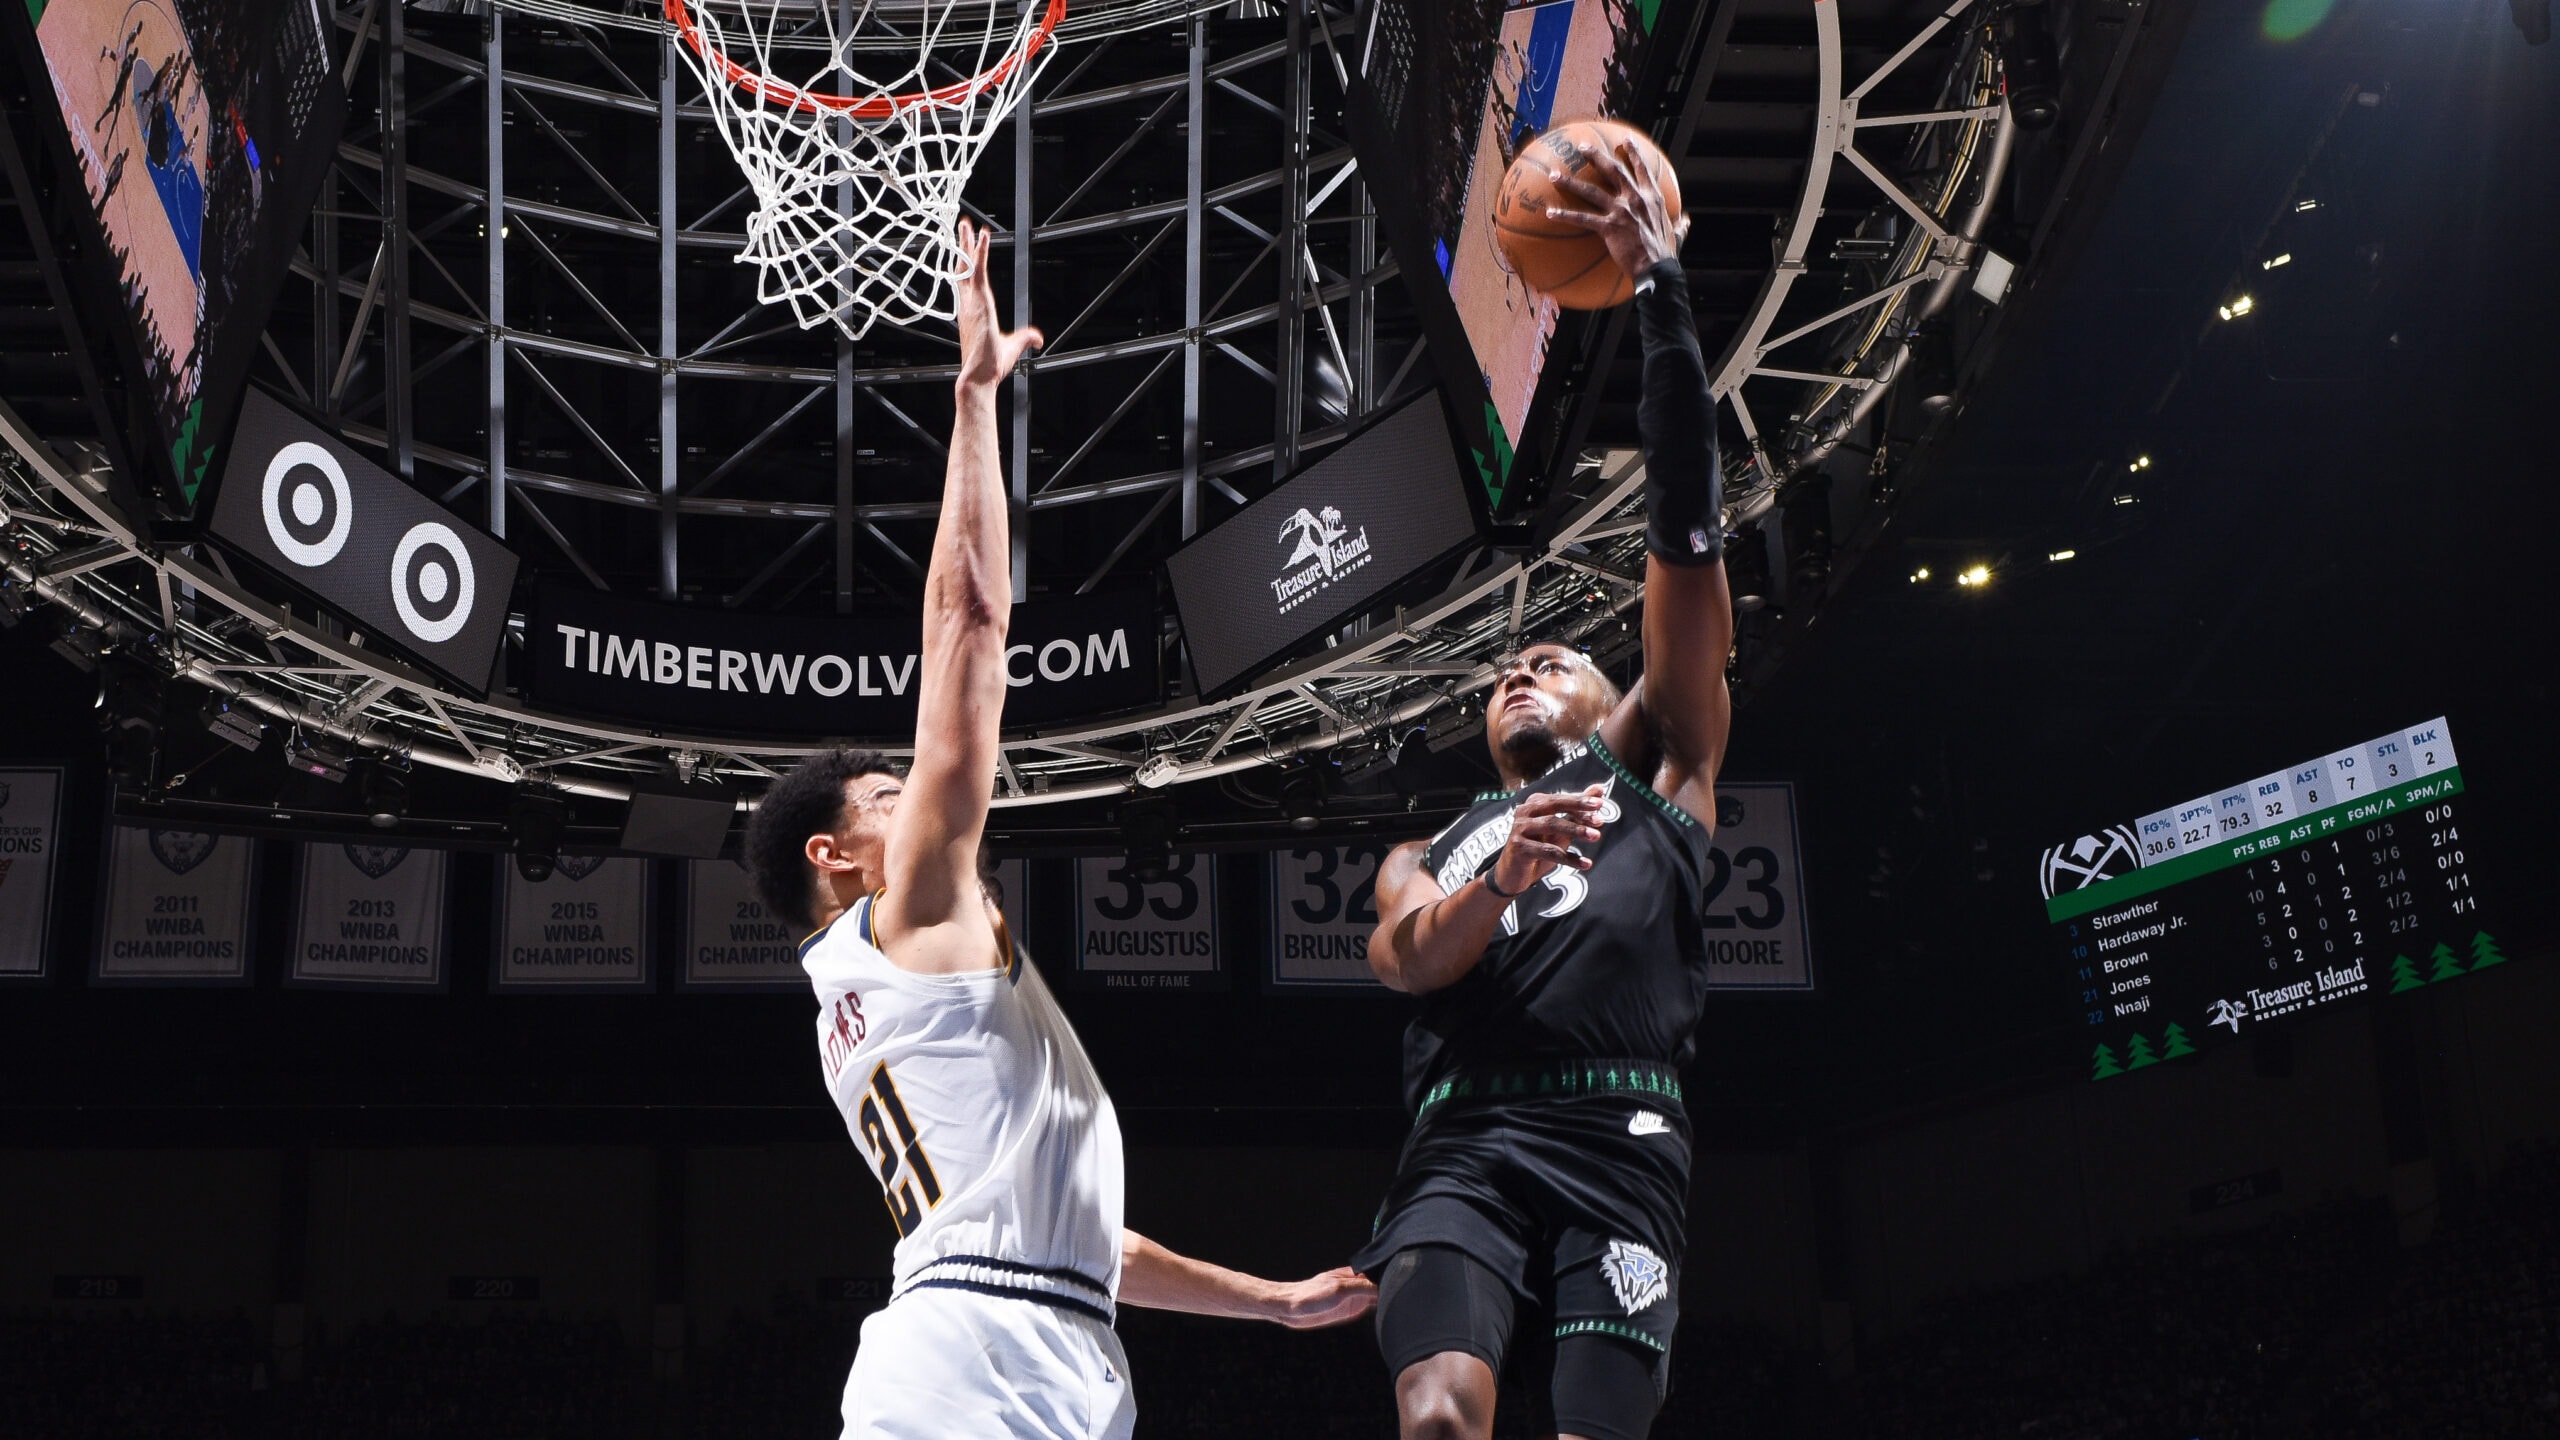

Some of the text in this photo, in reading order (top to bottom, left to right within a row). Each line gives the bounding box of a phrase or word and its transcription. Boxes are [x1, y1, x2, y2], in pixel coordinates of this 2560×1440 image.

[1271, 525, 1370, 603] Treasure Island
[557, 624, 1130, 697] TIMBERWOLVCOM
[2143, 729, 2437, 835] FG% 3PT% FT% REB AST TO STL BLK
[2147, 752, 2435, 856] 30.6 22.7 79.3 32 8 7 3 2
[22, 827, 42, 836] CUP
[2233, 779, 2453, 858] PTS REB AST PF FGM/A 3PM/A
[1094, 852, 1198, 921] 33
[1291, 847, 1388, 924] 32
[1702, 845, 1785, 930] 23
[2092, 900, 2159, 930] Strawther
[2248, 868, 2254, 880] 1
[2271, 860, 2280, 872] 3
[2301, 850, 2310, 863] 0
[2332, 841, 2339, 853] 1
[153, 895, 199, 913] 2011
[348, 899, 395, 918] 2013
[550, 902, 598, 920] 2015
[736, 902, 768, 919] 20
[2098, 923, 2165, 952] Hardaway
[2170, 916, 2187, 930] Jr.
[2248, 889, 2264, 904] 10
[2277, 881, 2287, 894] 4
[2308, 873, 2316, 885] 0
[2338, 864, 2346, 876] 1
[146, 918, 205, 935] WNBA
[340, 922, 400, 941] WNBA
[543, 924, 604, 943] WNBA
[729, 923, 790, 942] WNBA
[2103, 951, 2149, 973] Brown
[2258, 913, 2266, 925] 5
[2283, 904, 2292, 918] 2
[2315, 894, 2322, 907] 1
[2342, 886, 2352, 899] 2
[113, 940, 234, 959] CHAMPIONS
[307, 943, 428, 965] CHAMPIONS
[512, 946, 634, 966] CHAMPIONS
[699, 946, 800, 965] CHAMPIO
[1086, 930, 1211, 956] AUGUSTUS
[1284, 934, 1368, 960] BRUNS
[2110, 975, 2151, 995] Jones
[2263, 935, 2272, 947] 3
[2289, 927, 2297, 939] 0
[2319, 917, 2328, 930] 0
[2348, 909, 2358, 922] 2
[1106, 975, 1191, 987] HALL OF FAME
[2114, 995, 2150, 1017] Nnaji
[2269, 957, 2278, 970] 6
[2294, 949, 2304, 963] 2
[2325, 940, 2334, 952] 0
[2354, 931, 2363, 945] 2
[2247, 958, 2365, 1011] Treasure Island
[2255, 1003, 2302, 1021] RESORT
[2320, 984, 2368, 1002] CASINO
[858, 1057, 945, 1240] 21
[78, 1278, 118, 1298] 219
[474, 1278, 513, 1298] 220
